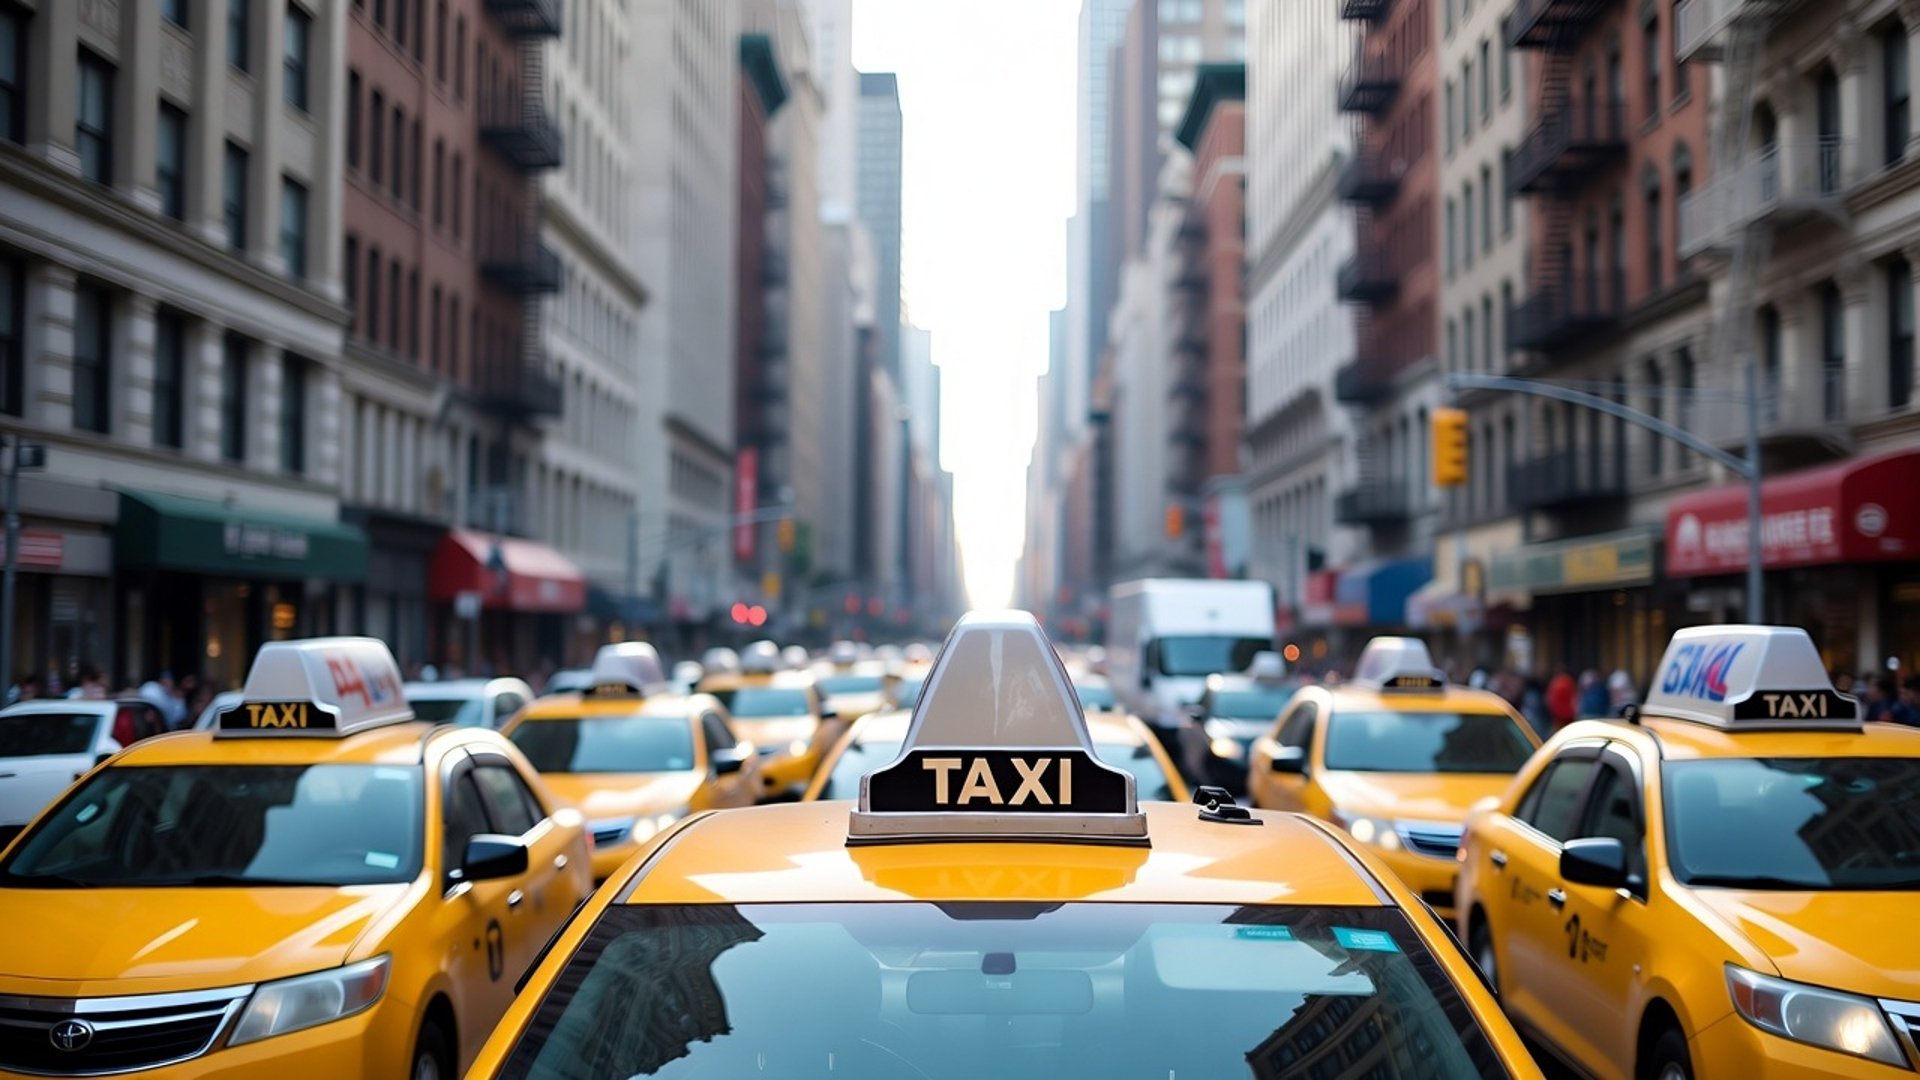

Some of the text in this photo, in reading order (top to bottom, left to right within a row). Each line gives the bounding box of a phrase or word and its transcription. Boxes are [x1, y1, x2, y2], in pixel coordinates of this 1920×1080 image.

[245, 704, 308, 728] TAXI
[1763, 694, 1827, 717] TAXI
[922, 758, 1072, 805] TAXI
